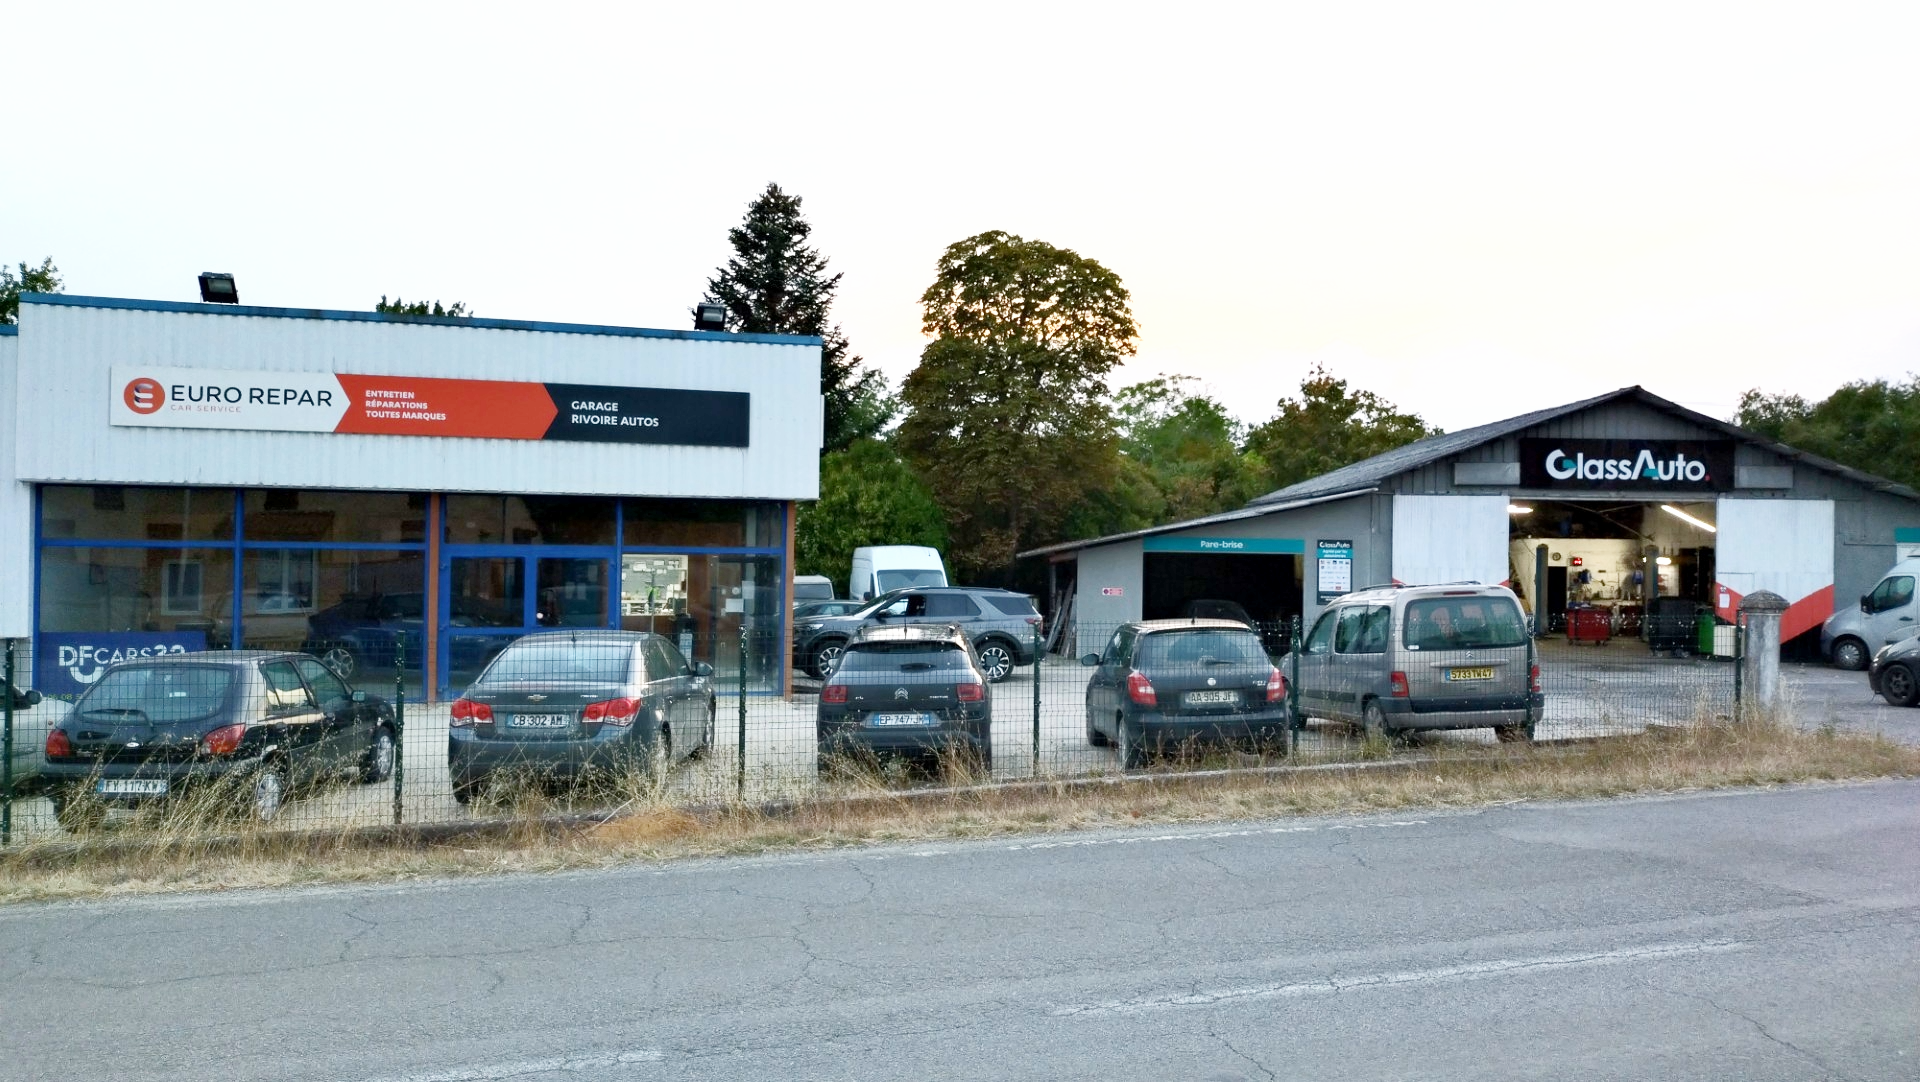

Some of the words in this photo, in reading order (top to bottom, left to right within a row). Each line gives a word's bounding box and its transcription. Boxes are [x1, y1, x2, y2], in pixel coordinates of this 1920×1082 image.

[171, 384, 242, 404] EURO
[249, 387, 333, 408] REPAR
[365, 389, 415, 399] ENTRETIEN
[170, 404, 193, 412] CAR
[196, 404, 242, 413] SERVICE
[365, 399, 428, 410] RÉPARATIONS
[571, 400, 619, 412] GARAGE
[366, 410, 401, 419] TOUTES
[402, 411, 447, 421] MARQUES
[571, 414, 618, 425] RIVOIRE
[620, 416, 660, 427] AUTOS
[1200, 540, 1244, 549] Pare-brise
[512, 714, 564, 727] CB-302-AM
